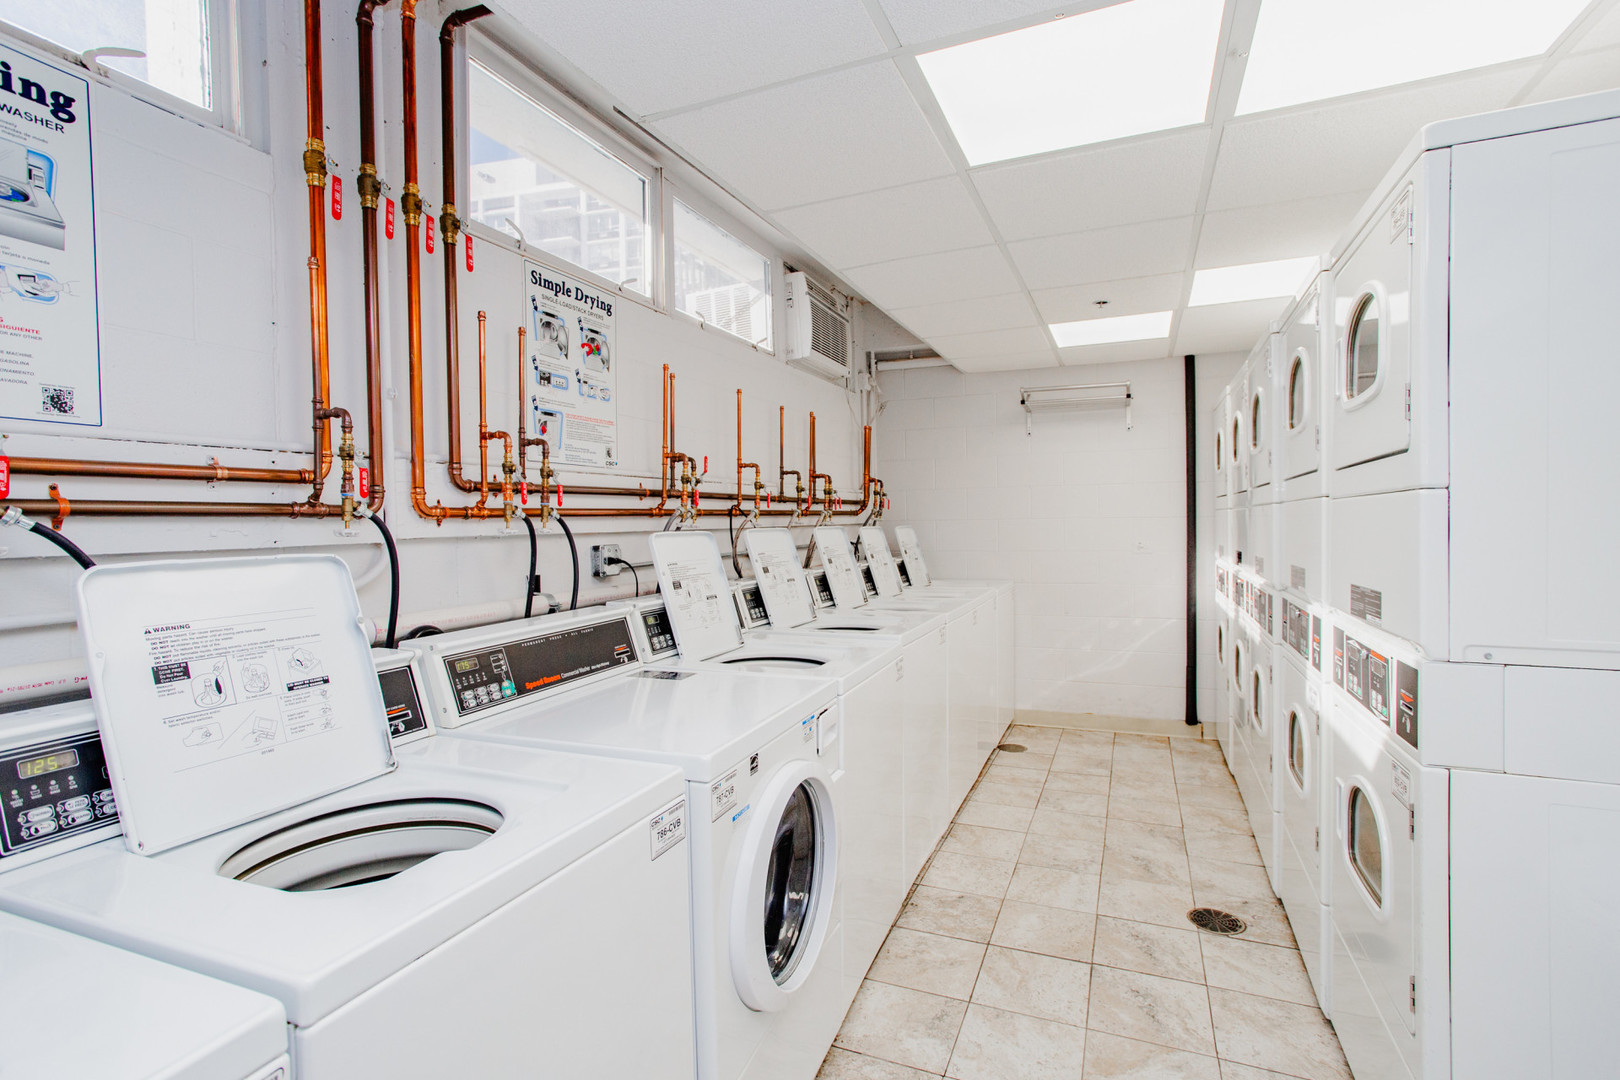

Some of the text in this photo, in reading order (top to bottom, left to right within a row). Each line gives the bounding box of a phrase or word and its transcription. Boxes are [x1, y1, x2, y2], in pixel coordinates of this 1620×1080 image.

[0, 103, 65, 134] WASHER
[530, 270, 572, 298] Simple
[574, 286, 613, 317] Drying
[152, 624, 191, 633] WARNING
[524, 677, 544, 690] Speed
[26, 756, 58, 776] 125
[657, 818, 682, 841] 786-CVB
